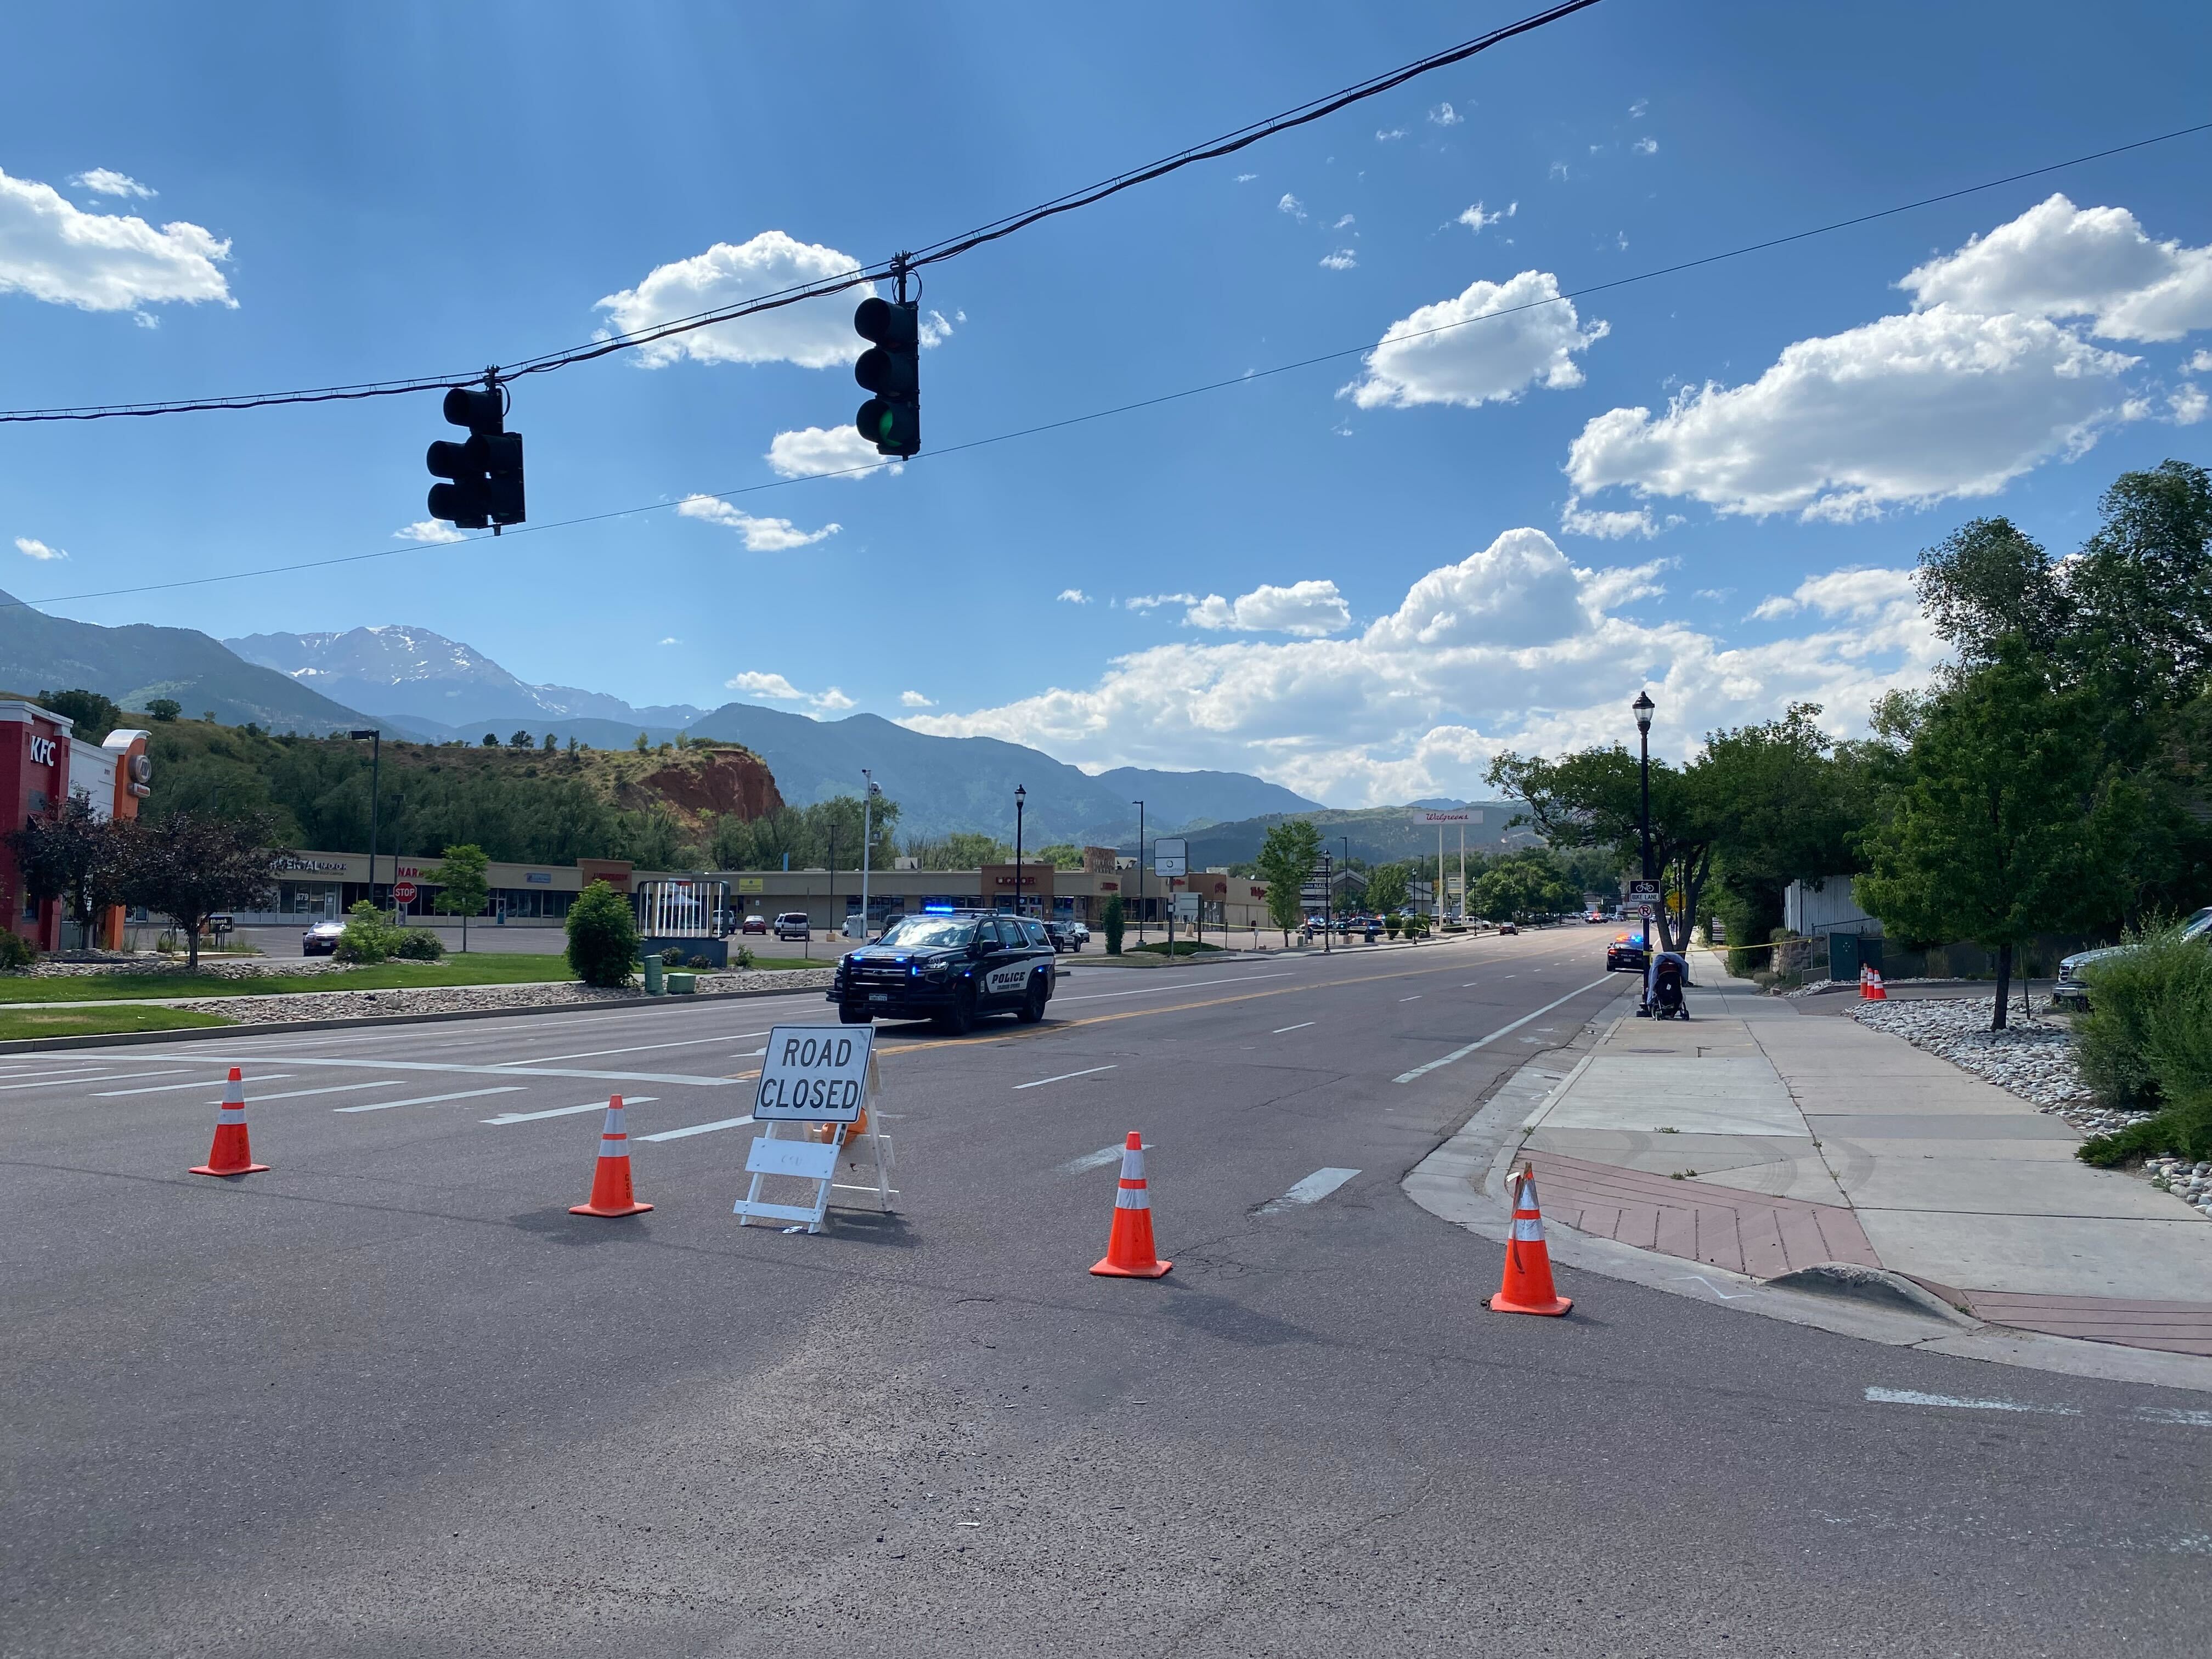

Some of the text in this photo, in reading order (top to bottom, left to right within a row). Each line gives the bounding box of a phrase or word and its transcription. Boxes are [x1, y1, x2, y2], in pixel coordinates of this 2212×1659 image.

[31, 735, 55, 766] KFC
[1426, 812, 1469, 822] Walgreens
[395, 888, 414, 897] STOP
[991, 972, 1026, 984] POLICE
[782, 1039, 851, 1068] ROAD
[760, 1079, 859, 1109] CLOSED
